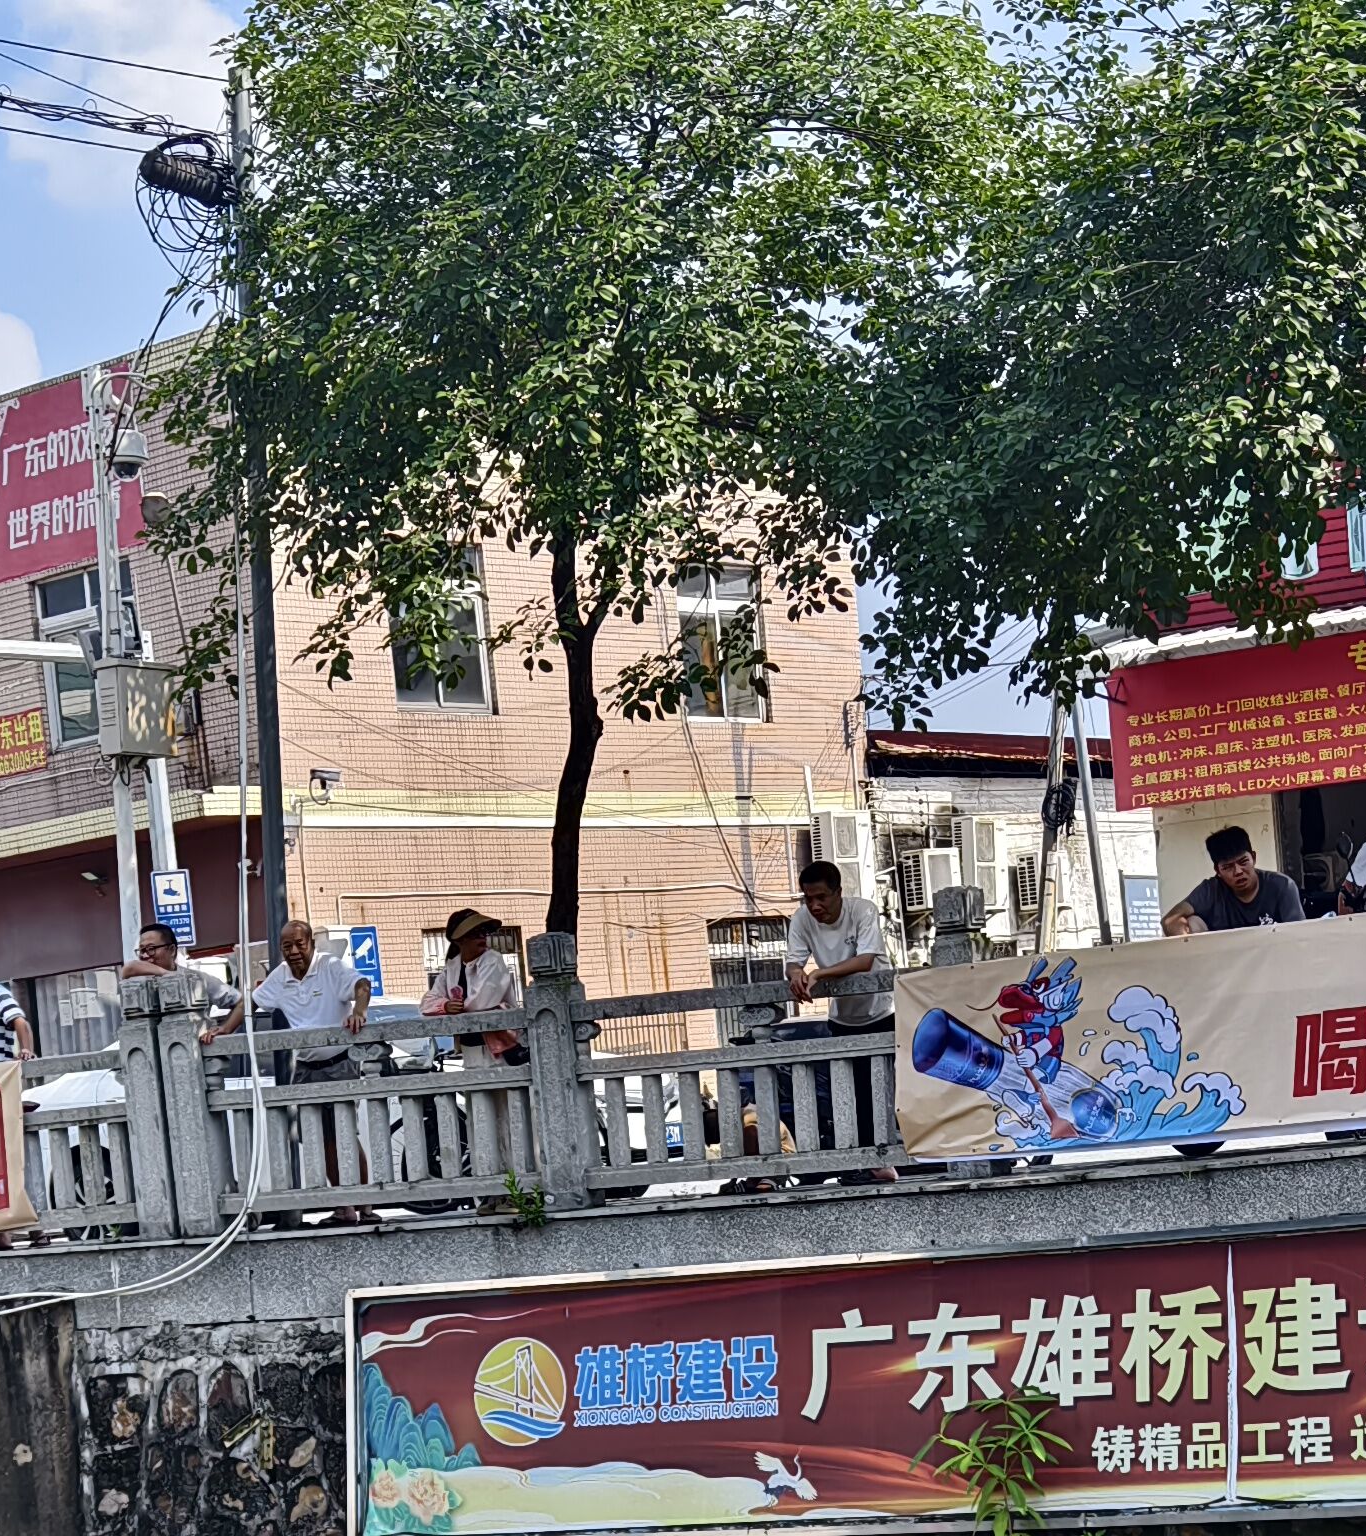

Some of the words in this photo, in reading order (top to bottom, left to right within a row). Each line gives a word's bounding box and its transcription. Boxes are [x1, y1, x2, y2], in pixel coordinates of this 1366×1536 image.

[574, 1334, 779, 1409] 雄桥建设
[574, 1405, 656, 1428] XIONGQIAO
[658, 1399, 779, 1423] CONSTRUCTION
